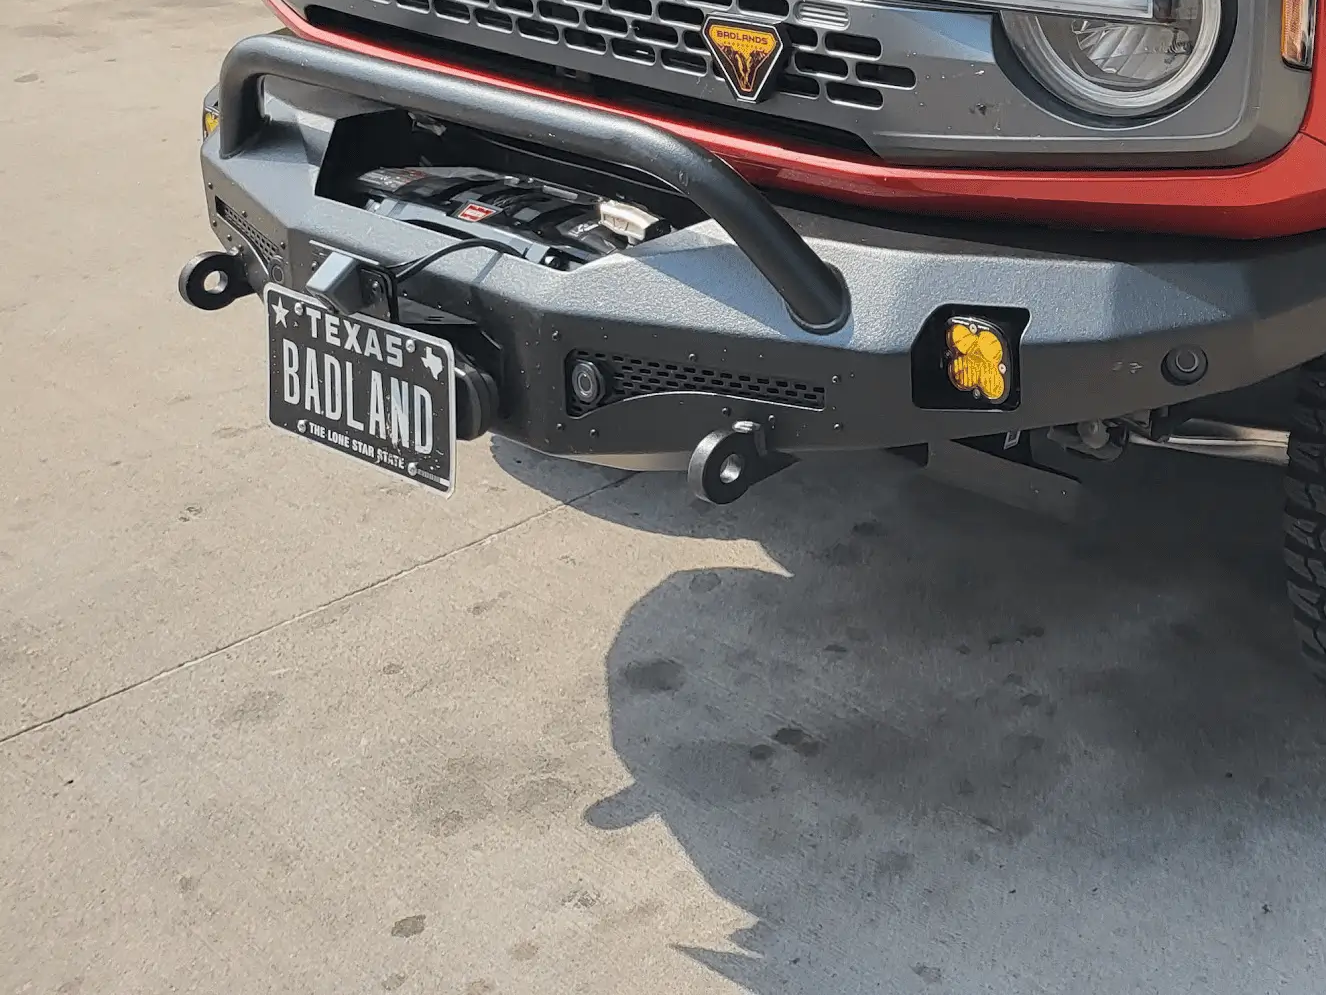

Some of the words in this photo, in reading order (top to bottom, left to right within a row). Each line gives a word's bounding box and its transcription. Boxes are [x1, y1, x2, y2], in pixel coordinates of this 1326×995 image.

[716, 30, 768, 45] BADLANDS
[306, 307, 404, 368] TEXAS
[282, 338, 433, 455] BADLAND
[309, 422, 326, 439] THE
[327, 428, 350, 448] LONE
[352, 438, 375, 458] STAR
[377, 447, 405, 470] STATE
